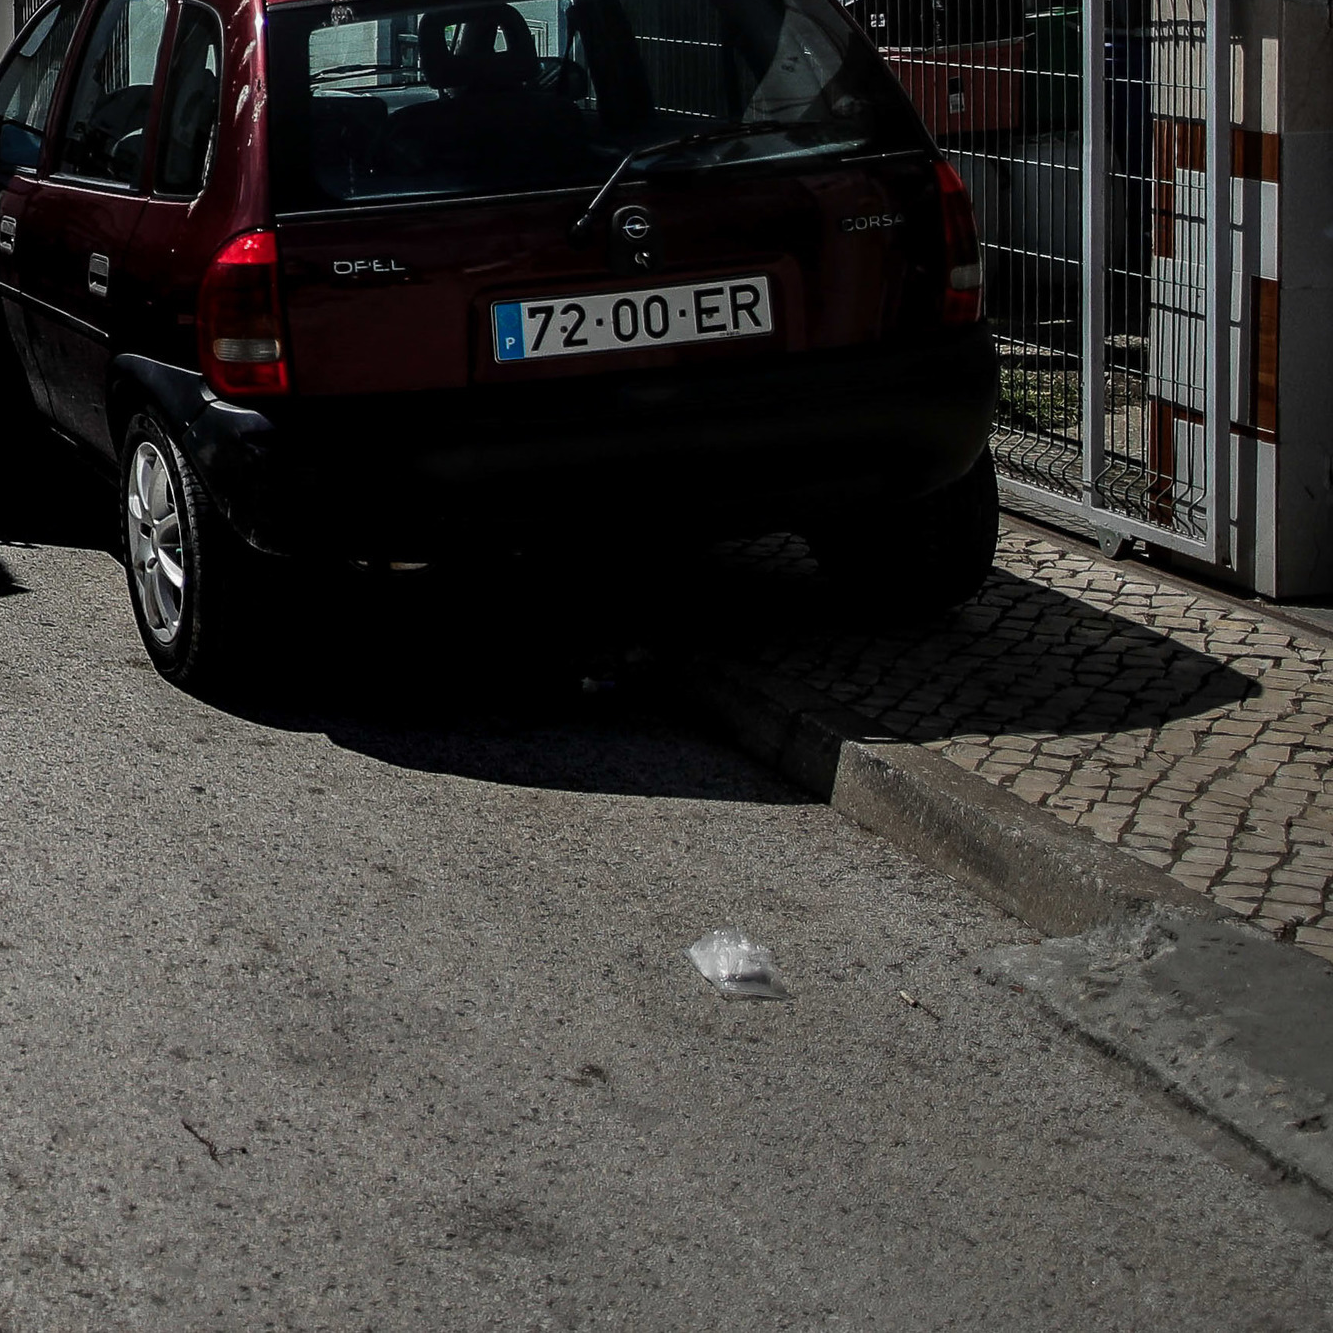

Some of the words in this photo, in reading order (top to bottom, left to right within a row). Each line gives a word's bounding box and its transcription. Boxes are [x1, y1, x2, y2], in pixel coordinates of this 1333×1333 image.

[841, 213, 905, 232] CORSA
[333, 259, 406, 275] OPEL
[505, 337, 516, 350] P
